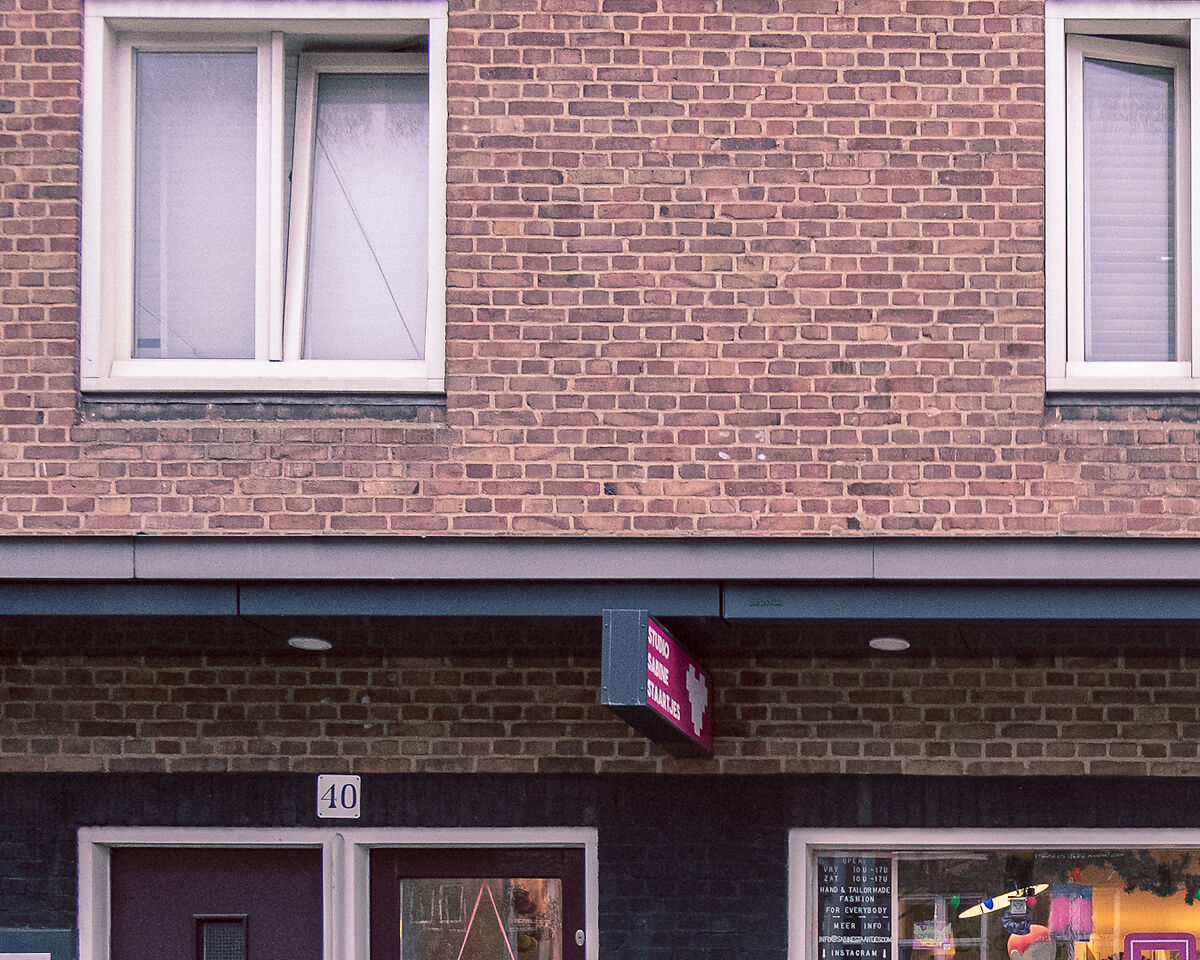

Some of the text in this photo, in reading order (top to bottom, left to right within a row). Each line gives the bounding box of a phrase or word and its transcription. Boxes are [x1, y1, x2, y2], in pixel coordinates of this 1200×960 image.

[648, 626, 670, 659] STUDIO
[648, 653, 669, 686] SABINE
[647, 679, 681, 720] STAARTJES
[321, 783, 357, 809] 40
[820, 886, 839, 894] HAND
[826, 906, 887, 914] FOR EVERYBODY
[833, 922, 882, 930] MEER INFO
